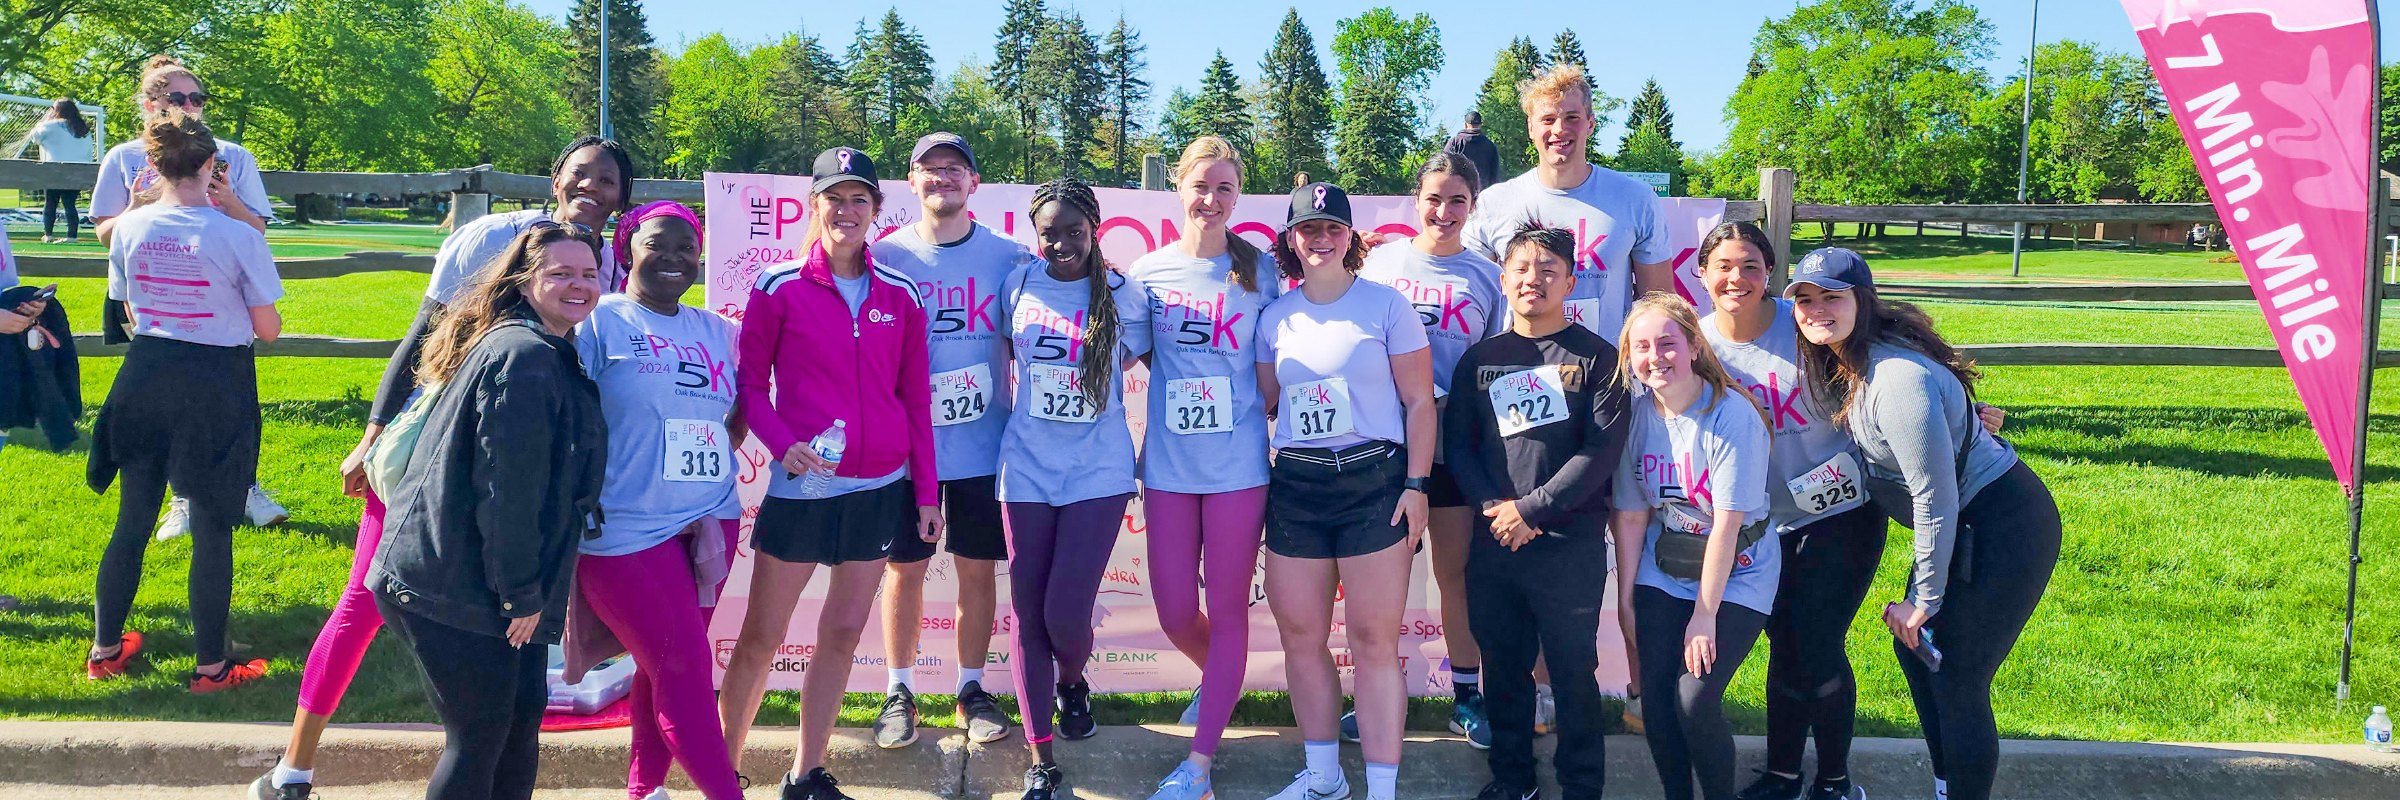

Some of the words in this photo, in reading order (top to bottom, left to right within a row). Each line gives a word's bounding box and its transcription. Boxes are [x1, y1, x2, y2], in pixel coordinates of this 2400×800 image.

[2165, 33, 2224, 69] 7
[2184, 82, 2264, 222] Min.
[750, 197, 771, 239] THE
[138, 241, 199, 254] ALLEGIANT
[750, 247, 794, 263] 2024
[1153, 290, 1166, 315] THE
[2245, 223, 2340, 363] Mile
[629, 334, 651, 358] THE
[637, 362, 671, 374] 2024
[674, 388, 688, 397] Oak
[1043, 392, 1085, 418] 323
[941, 392, 985, 421] 324
[1177, 405, 1219, 430] 321
[1507, 394, 1554, 428] 322
[1300, 408, 1337, 436] 317
[680, 450, 720, 477] 313
[1810, 478, 1858, 512] 325
[1106, 653, 1158, 663] BANK
